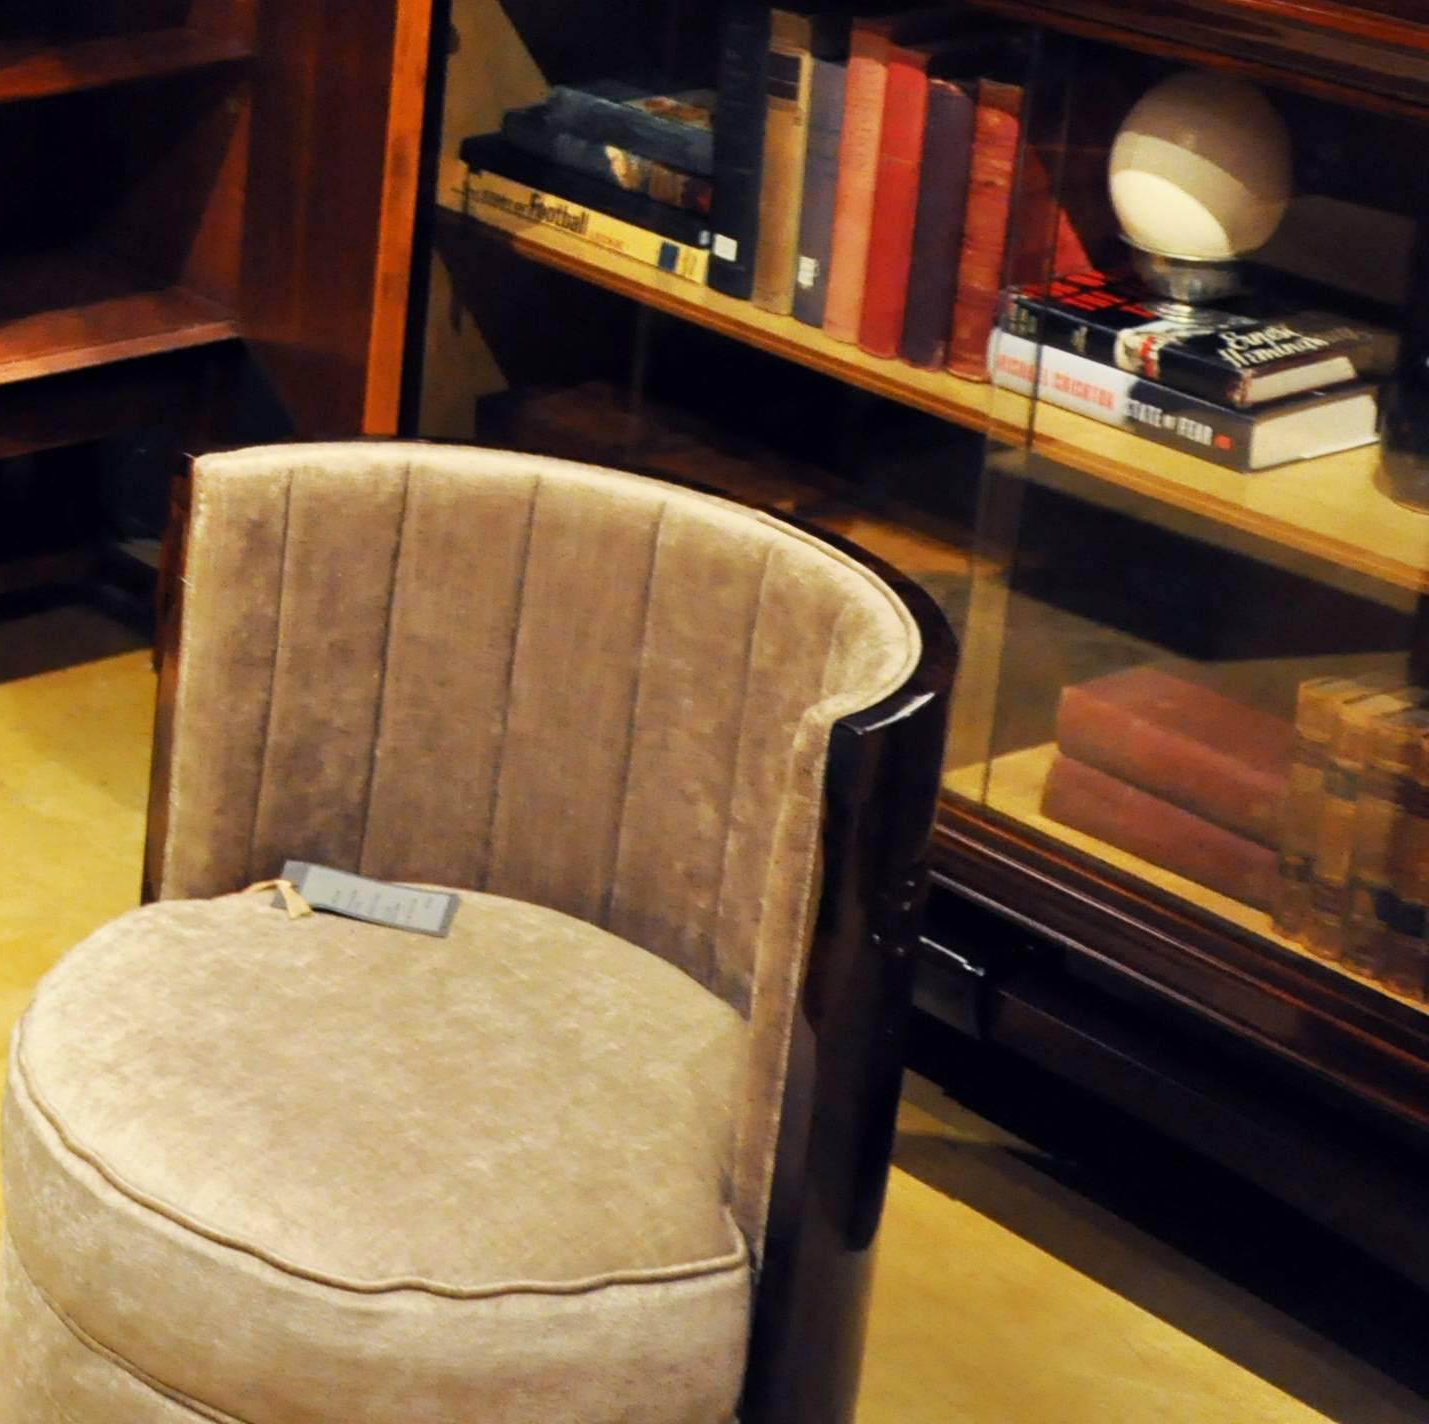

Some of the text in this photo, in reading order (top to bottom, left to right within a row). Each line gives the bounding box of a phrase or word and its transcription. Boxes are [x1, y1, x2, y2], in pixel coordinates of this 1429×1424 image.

[531, 191, 590, 236] Football
[1126, 398, 1162, 427] STATE
[1177, 416, 1213, 446] FEAR
